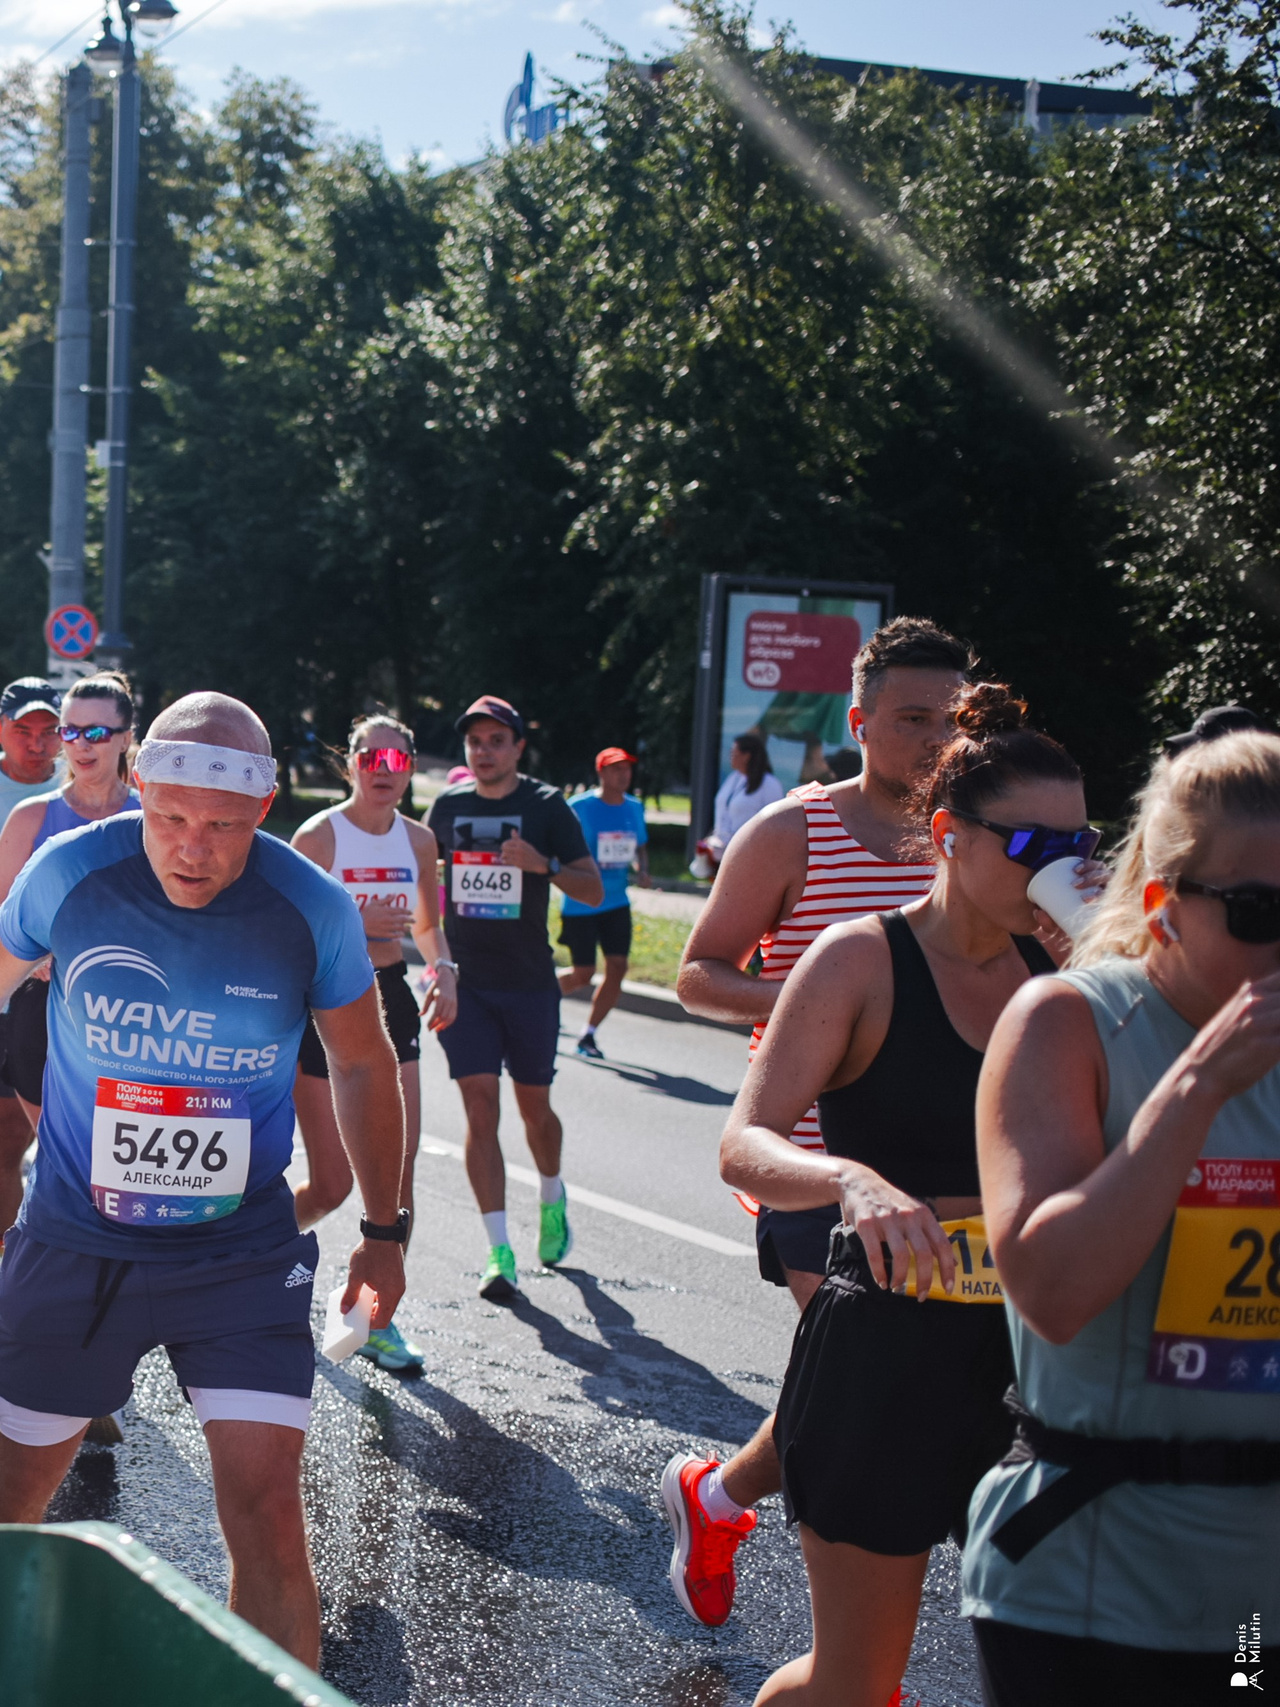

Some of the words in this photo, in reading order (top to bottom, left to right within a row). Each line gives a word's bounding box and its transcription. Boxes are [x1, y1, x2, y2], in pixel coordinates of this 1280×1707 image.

[461, 871, 512, 891] 6648
[239, 991, 279, 1000] ATHLETICS
[84, 991, 217, 1040] WAVE
[84, 1023, 279, 1071] RUNNERS
[122, 1063, 187, 1081] СООБЩЕСТВО
[189, 1074, 203, 1082] НА
[204, 1073, 258, 1085] ЮГО-ЗАПАДЕ
[117, 1083, 142, 1095] ПОЛУ
[116, 1092, 164, 1106] МАРАФОН
[185, 1096, 208, 1109] 21,1
[211, 1097, 232, 1109] КМ
[113, 1121, 228, 1173] 5496
[1205, 1163, 1243, 1177] ПОЛУ
[123, 1171, 213, 1190] АЛЕКСАНДР
[1206, 1178, 1276, 1192] МАРАФОН
[105, 1191, 120, 1216] E
[1176, 1342, 1207, 1380] D
